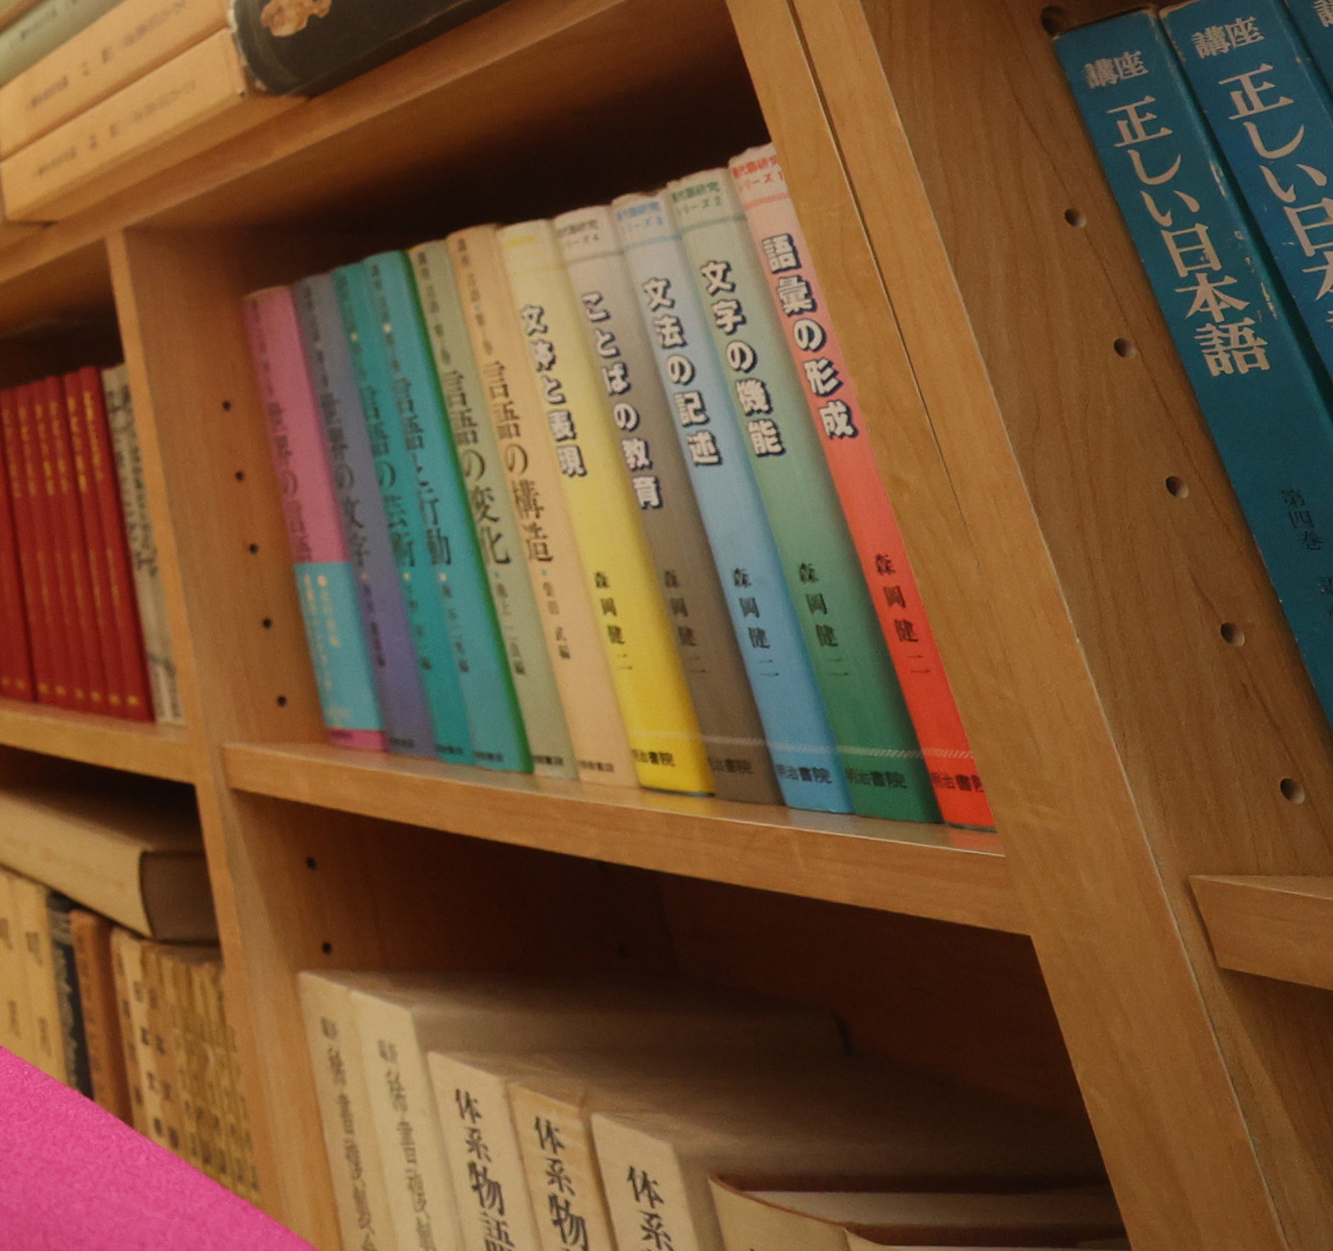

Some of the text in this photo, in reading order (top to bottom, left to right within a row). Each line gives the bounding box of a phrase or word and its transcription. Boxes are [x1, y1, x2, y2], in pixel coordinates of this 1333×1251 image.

[1083, 49, 1152, 90] 講座
[1190, 13, 1267, 61] 講座
[1104, 94, 1273, 380] 正しい日本語
[580, 291, 662, 509] ことばの教育
[642, 277, 723, 466] 文法の記述
[700, 261, 784, 458] 文字の機能
[762, 234, 858, 441] 語彙の形成
[443, 368, 512, 569] 言語の変化
[483, 360, 554, 566] 言語の構造
[591, 569, 634, 672] 森岡健二
[663, 568, 707, 675] 森岡健二
[731, 565, 781, 680] 森岡健二
[798, 560, 850, 680] 森岡健二
[874, 551, 933, 677] 森岡健二
